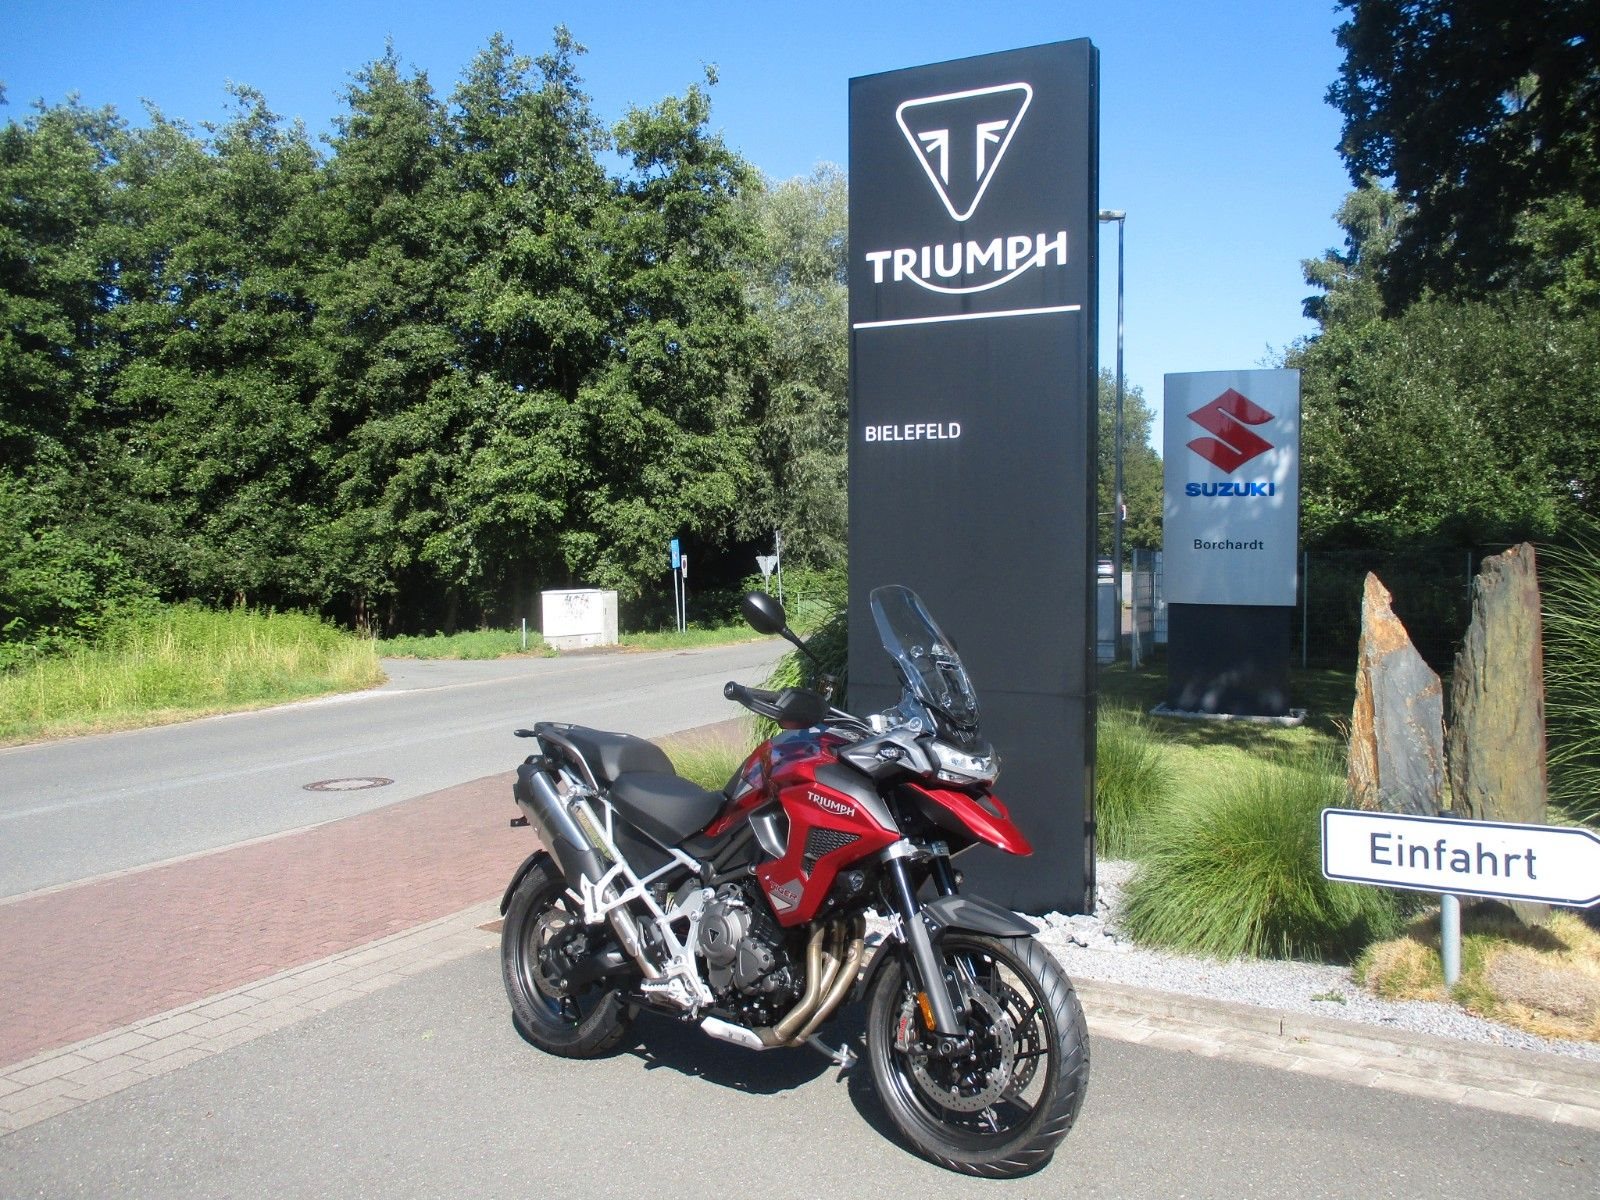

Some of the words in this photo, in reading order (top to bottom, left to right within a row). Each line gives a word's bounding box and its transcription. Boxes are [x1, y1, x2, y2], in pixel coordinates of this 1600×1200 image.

[865, 230, 1067, 294] TRIUMPH
[865, 422, 961, 442] BIELEFELD
[1185, 482, 1275, 497] SUZUKI
[1193, 538, 1264, 550] Borchardt
[807, 790, 855, 817] TRIUMPH
[1370, 832, 1537, 880] Einfahrt
